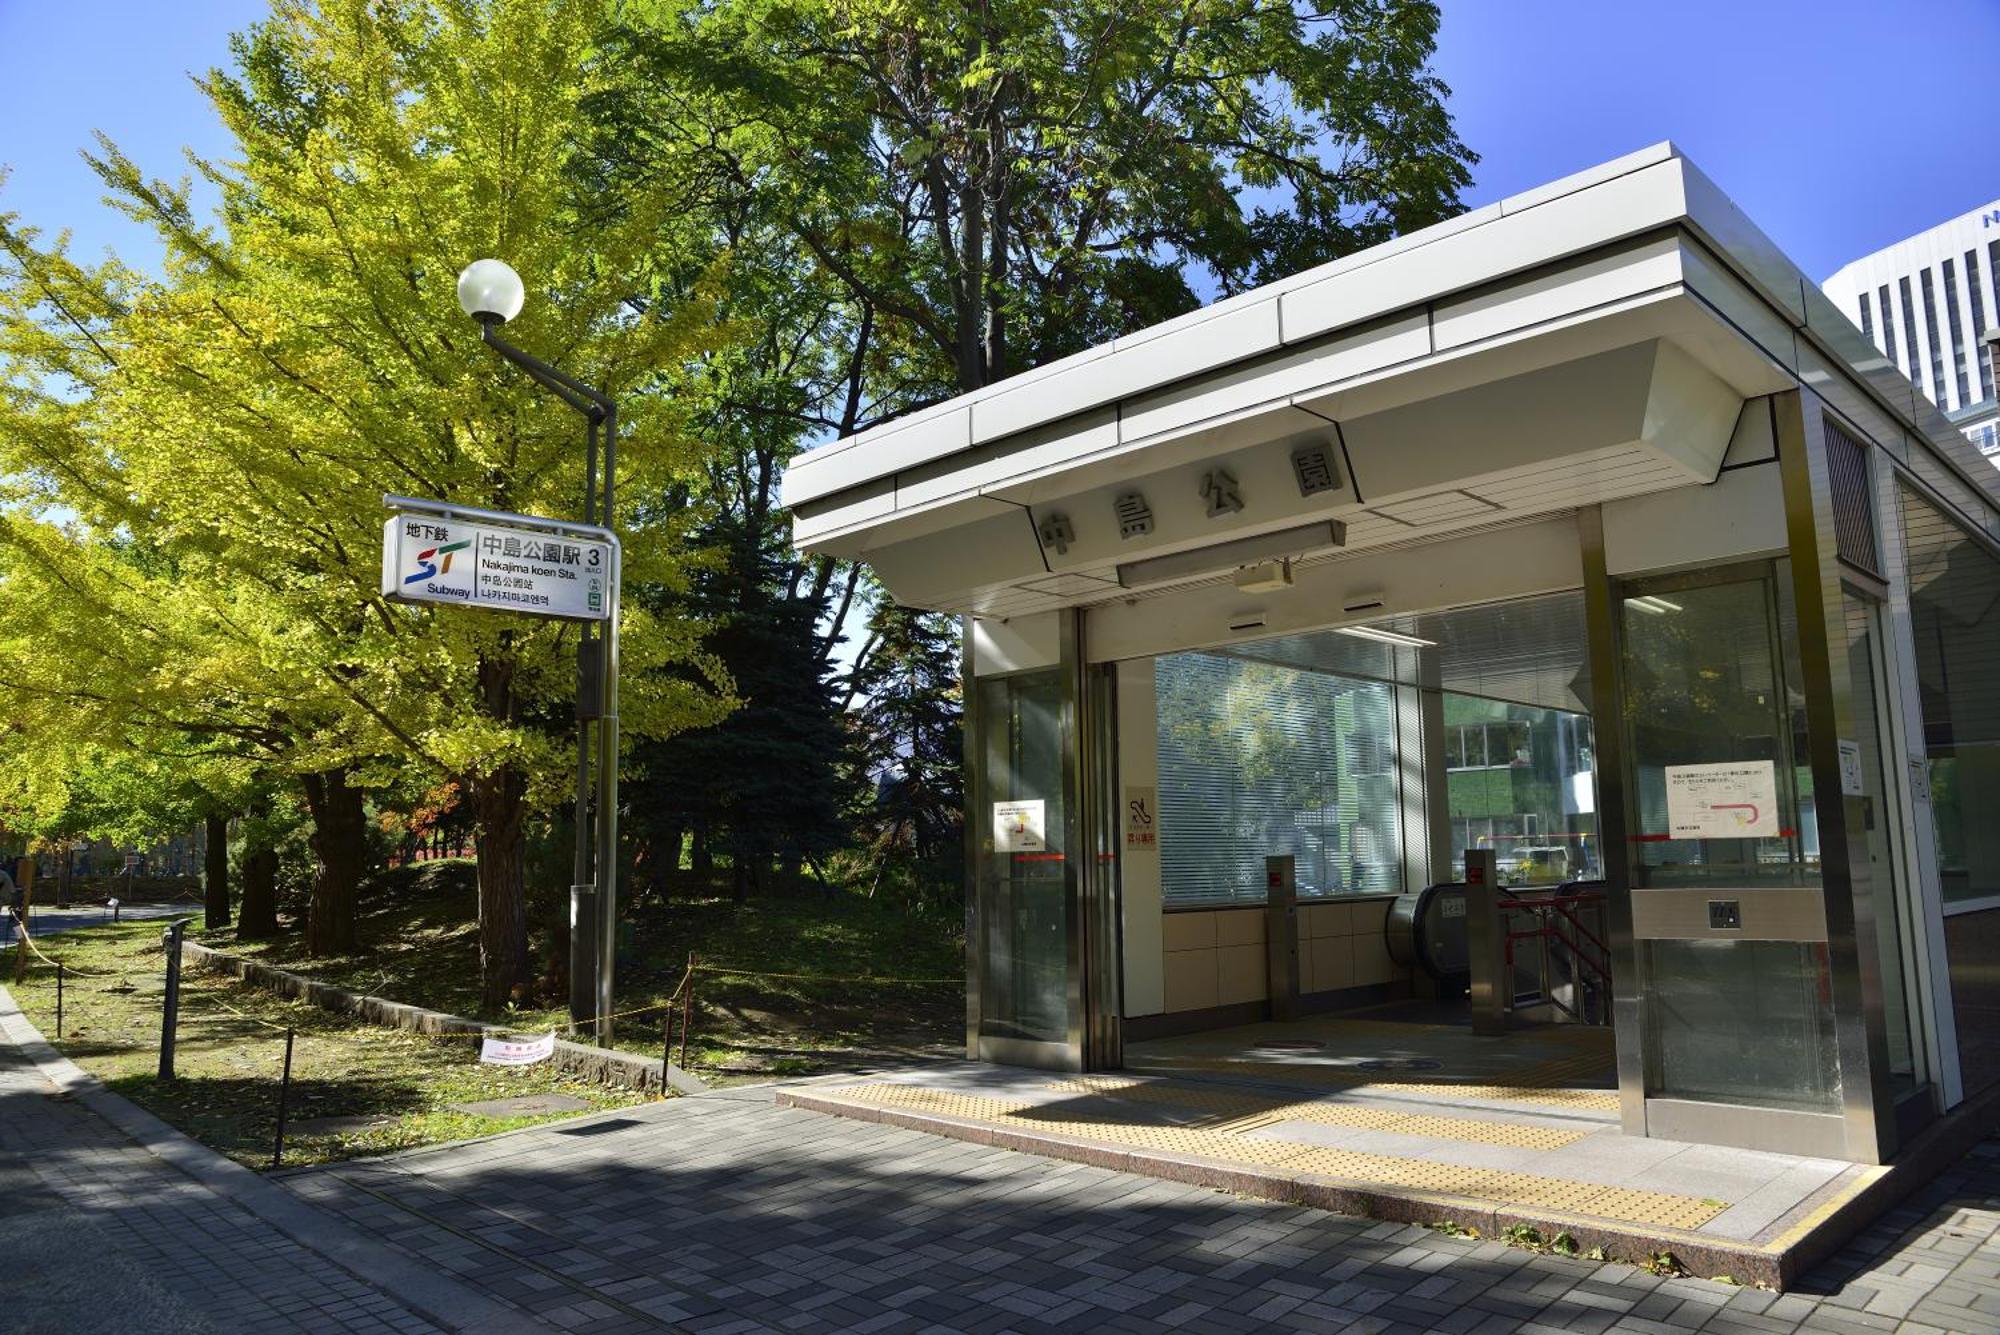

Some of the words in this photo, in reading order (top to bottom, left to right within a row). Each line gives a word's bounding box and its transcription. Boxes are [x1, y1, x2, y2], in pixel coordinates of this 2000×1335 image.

[406, 522, 449, 542] 地下鉄
[482, 534, 581, 566] 中島公園駅
[587, 549, 600, 566] 3
[482, 558, 529, 575] Nakajima
[531, 565, 557, 578] koen
[558, 568, 577, 581] Sta.
[427, 582, 471, 599] Subway
